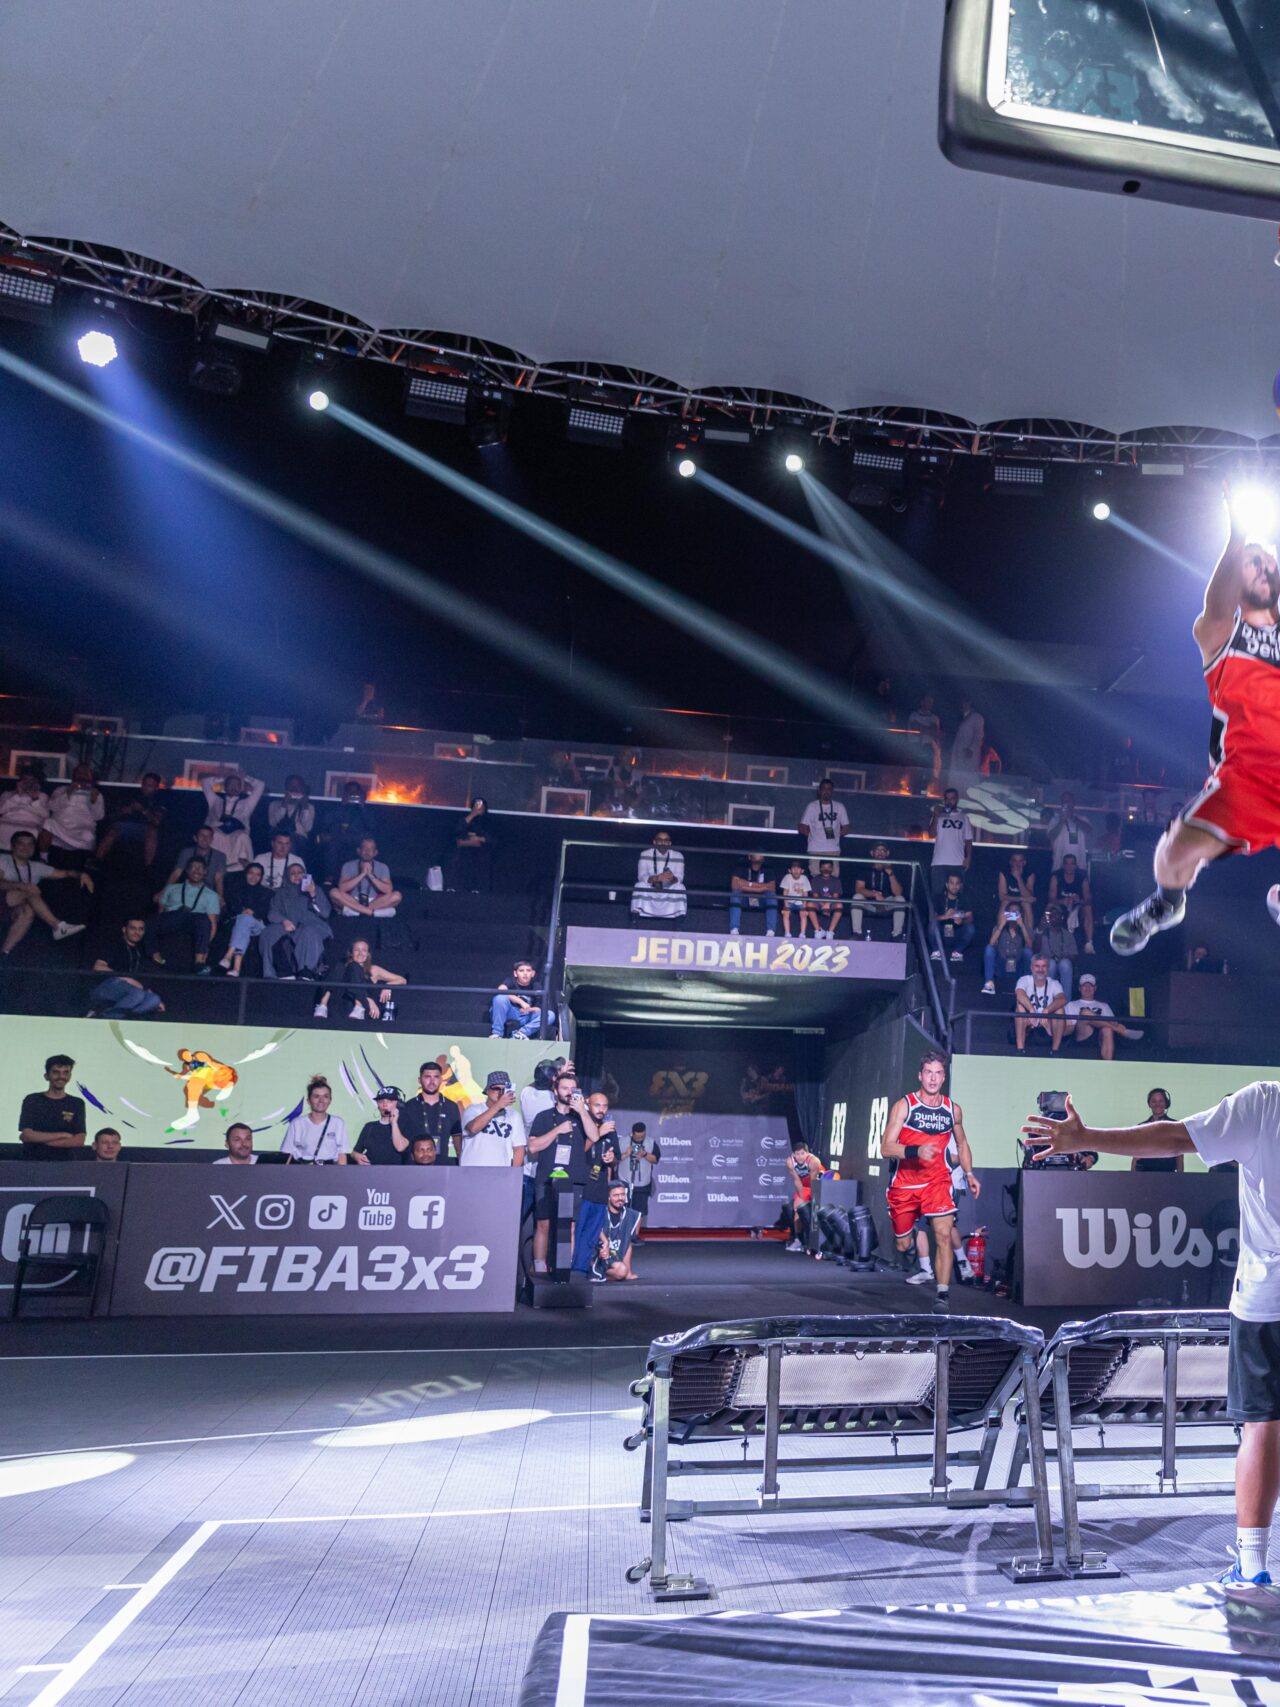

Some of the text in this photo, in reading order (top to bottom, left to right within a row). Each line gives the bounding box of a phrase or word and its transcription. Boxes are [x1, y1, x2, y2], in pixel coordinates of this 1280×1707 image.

[631, 937, 850, 973] JEDDAH 2023
[914, 1112, 951, 1126] Dunking
[918, 1120, 945, 1131] Devils
[659, 1136, 692, 1146] Wilson
[657, 1174, 690, 1184] Wilson
[367, 1188, 390, 1206] You
[707, 1193, 739, 1202] Wilson
[362, 1209, 393, 1227] Tube
[144, 1244, 491, 1293] @FIBA3x3
